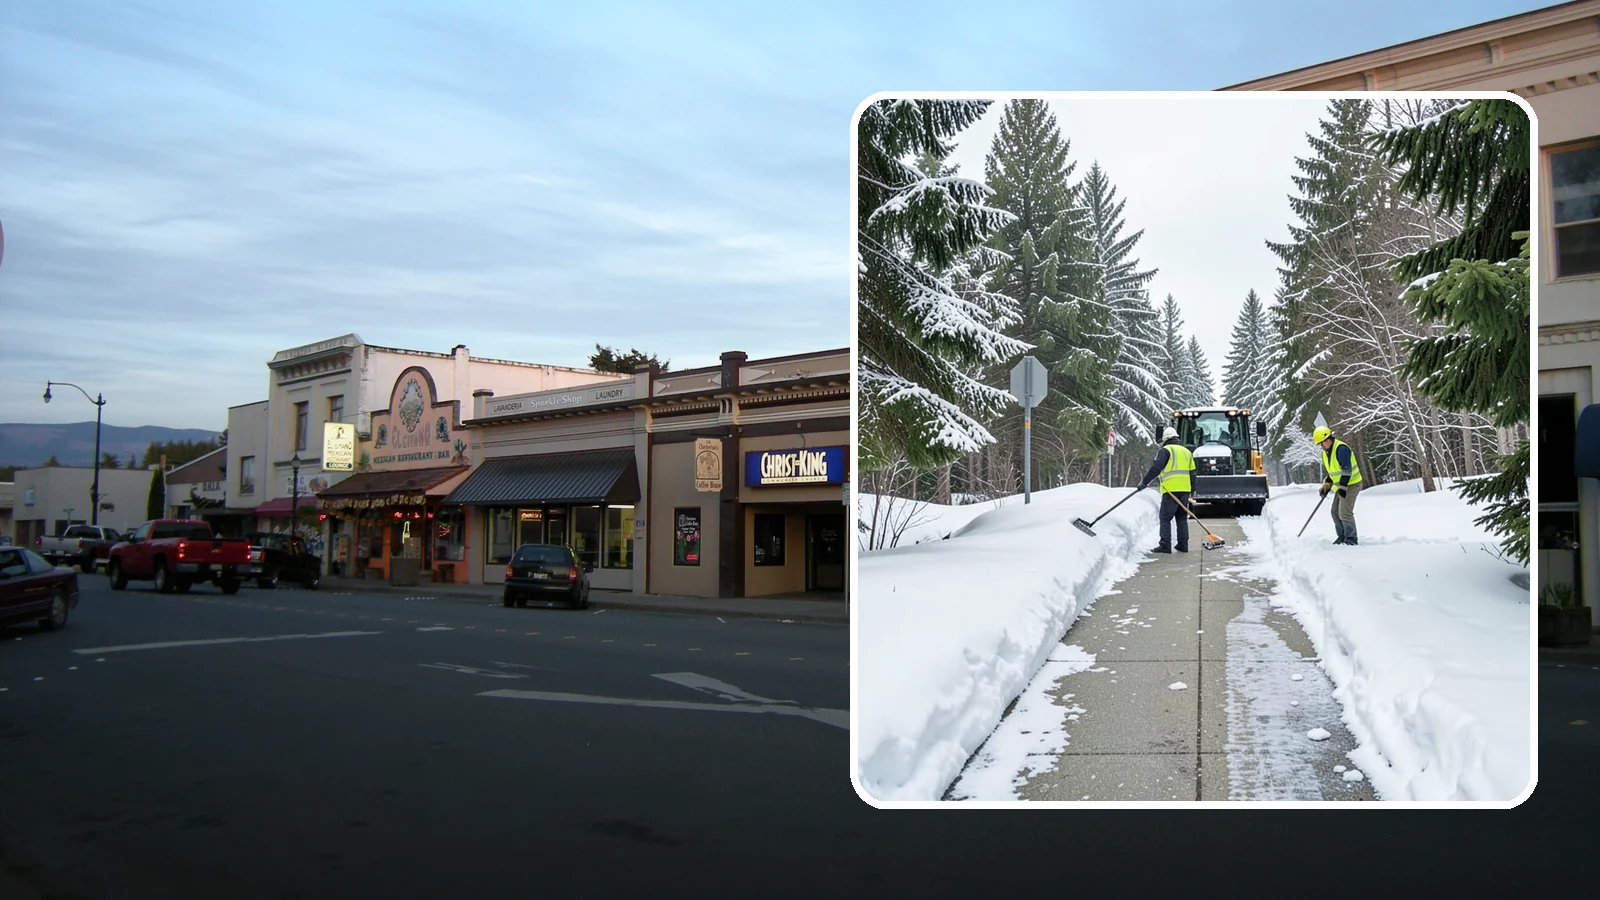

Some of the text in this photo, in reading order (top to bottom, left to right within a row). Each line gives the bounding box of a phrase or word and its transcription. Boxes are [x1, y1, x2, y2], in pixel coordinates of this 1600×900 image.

[493, 401, 523, 413] LAVANDERIA
[560, 394, 582, 405] Shop
[595, 389, 624, 400] LAUNDRY
[373, 455, 396, 464] MEXICAN
[397, 452, 433, 462] RESTAURANT
[437, 450, 450, 459] BAR
[761, 452, 797, 478] CHRIST
[799, 450, 827, 476] KING
[696, 481, 709, 489] Coffee
